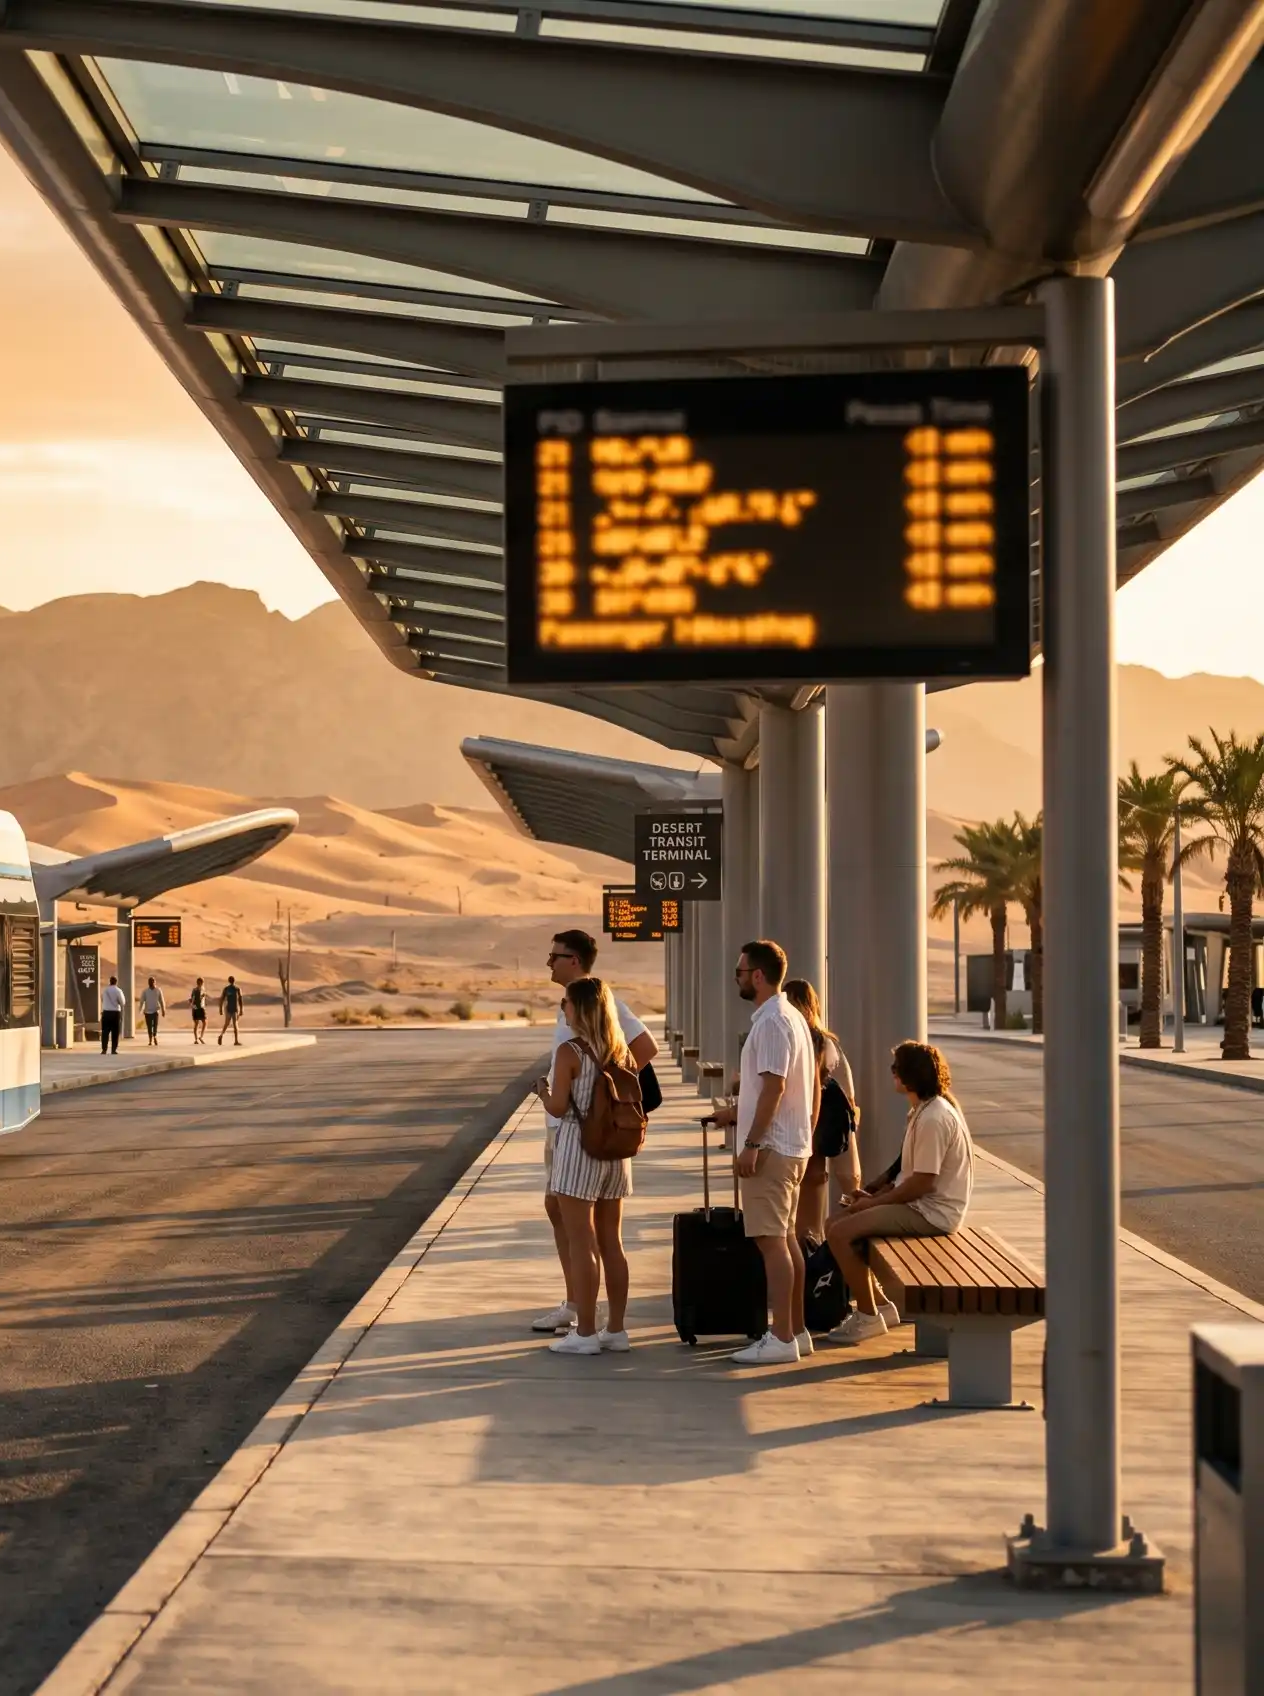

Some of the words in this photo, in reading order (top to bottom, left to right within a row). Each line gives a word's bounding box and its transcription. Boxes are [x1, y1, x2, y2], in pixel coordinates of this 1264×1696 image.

[652, 822, 703, 834] DESERT
[648, 836, 706, 847] TRANSIT
[642, 849, 712, 861] TERMINAL
